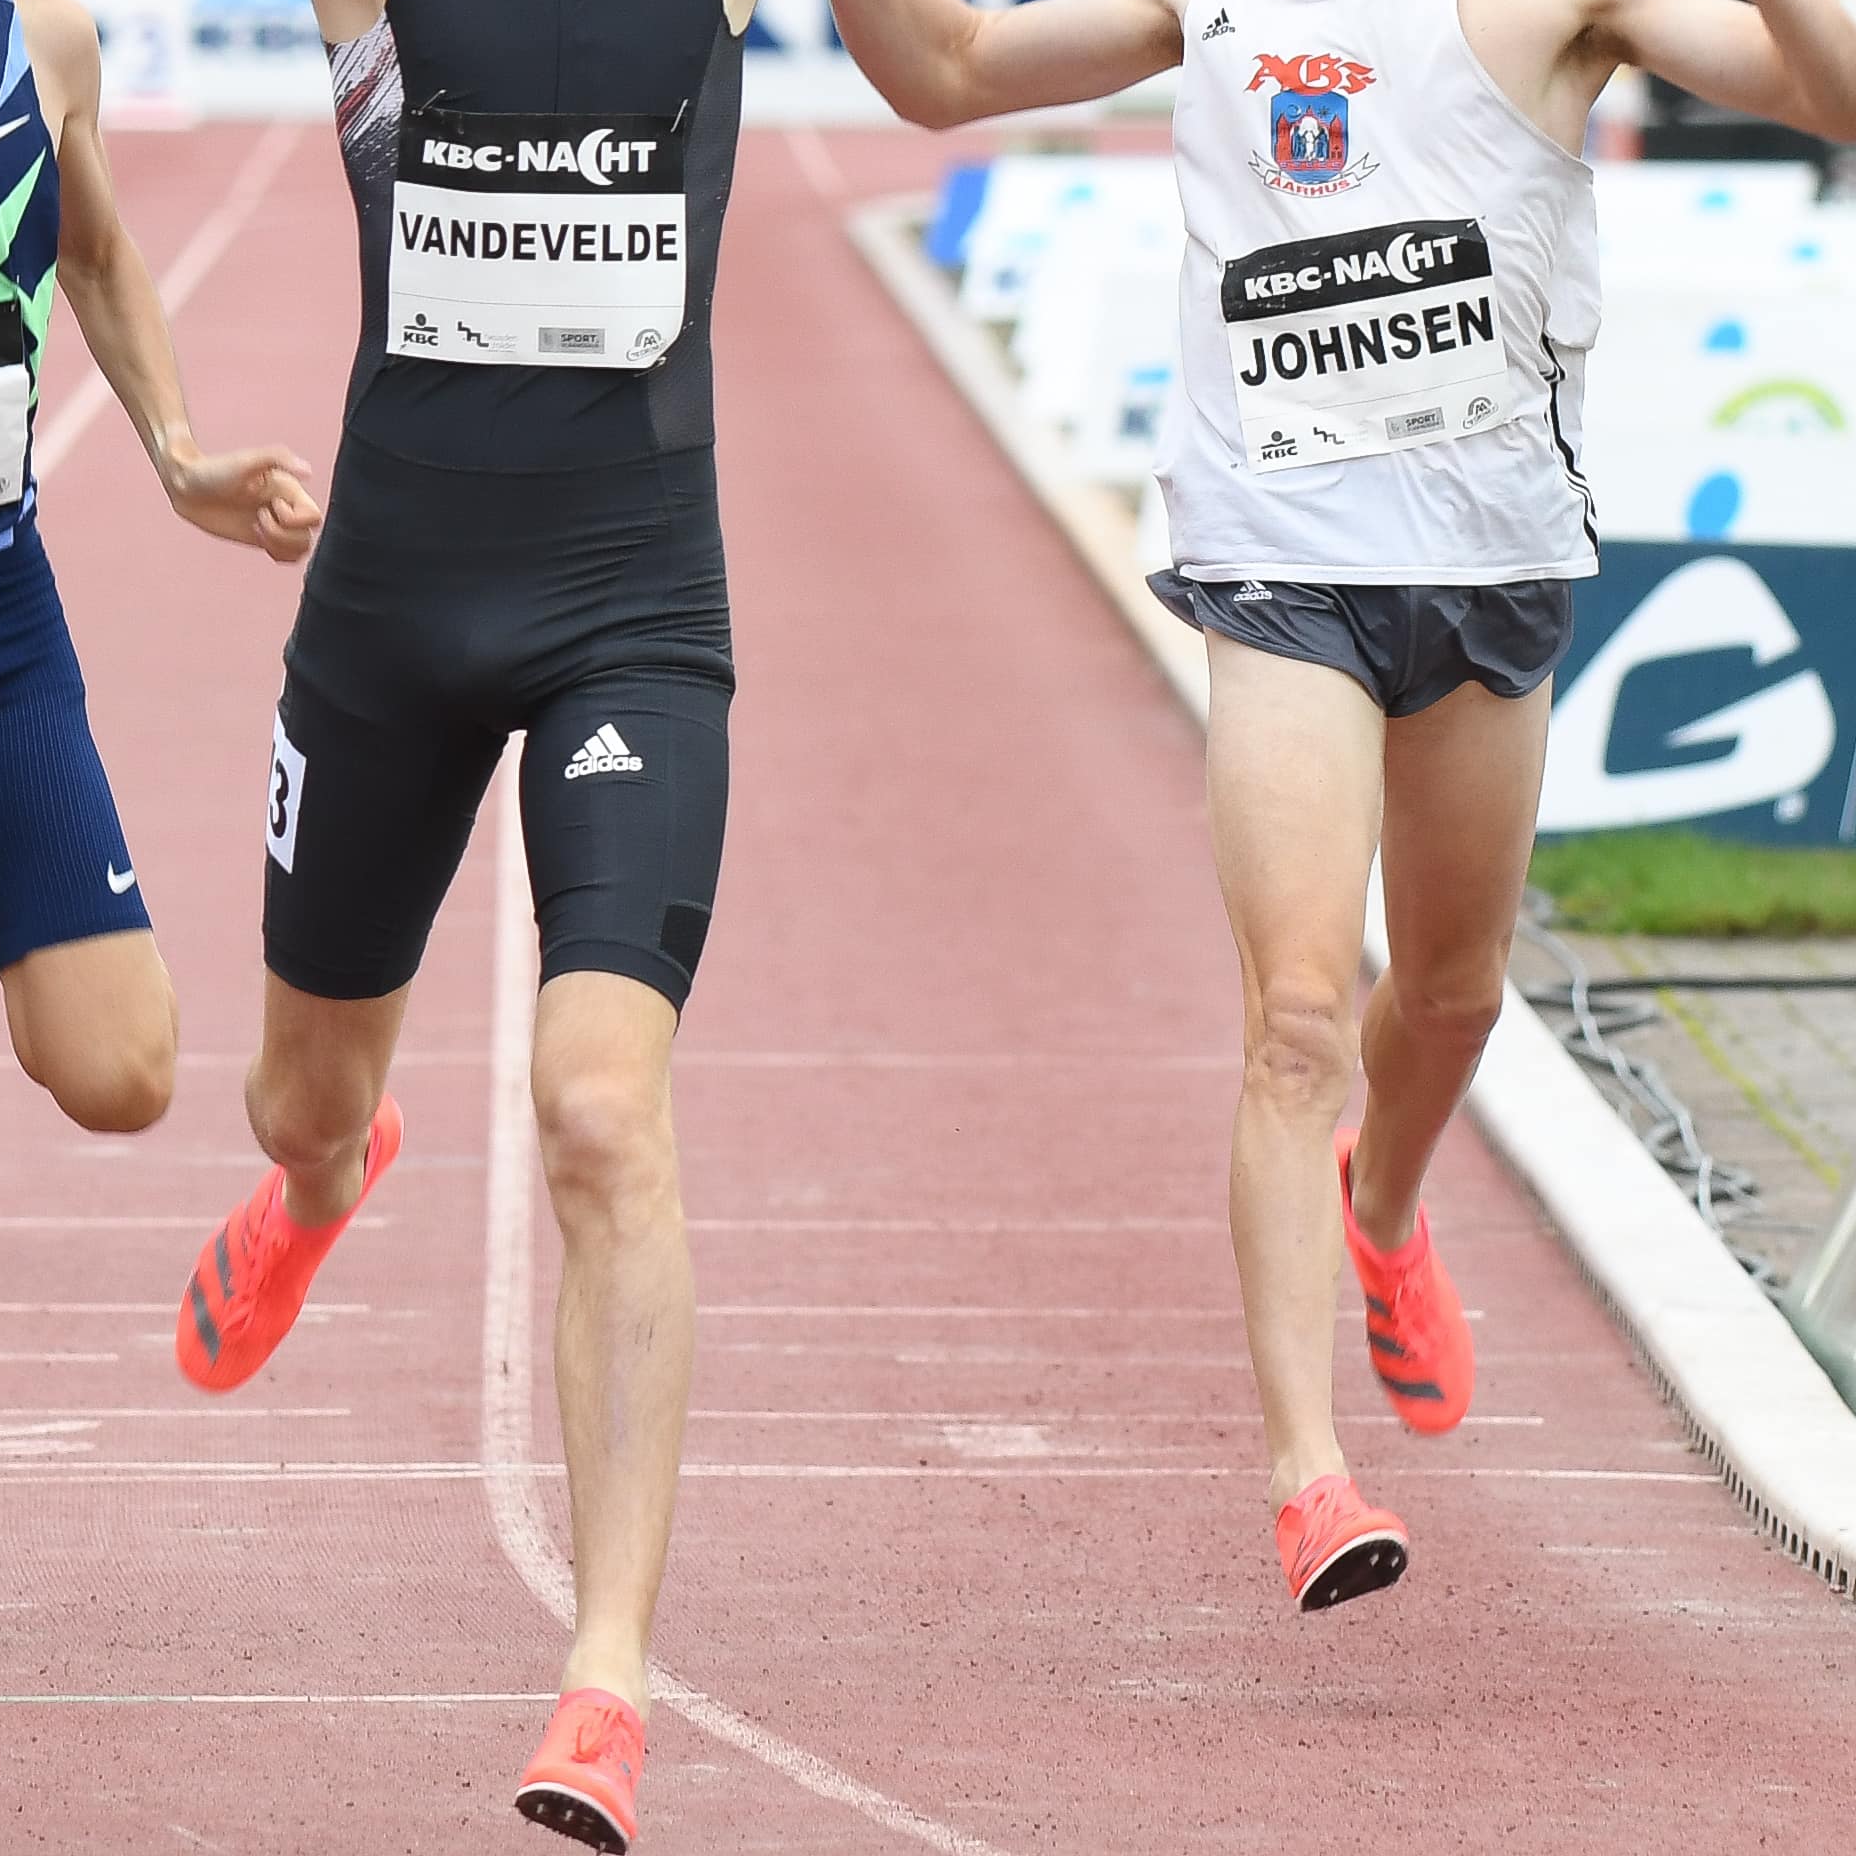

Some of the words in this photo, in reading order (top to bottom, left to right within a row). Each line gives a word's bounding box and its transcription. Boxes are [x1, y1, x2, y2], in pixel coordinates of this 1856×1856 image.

[422, 128, 657, 186] KBC-NACHT
[1268, 174, 1351, 197] AARHUS
[398, 211, 679, 262] VANDEVELDE
[1244, 232, 1459, 301] KBC-NACHT
[403, 331, 439, 347] KBC
[1240, 296, 1495, 386] JOHNSEN
[1261, 445, 1298, 461] KBC
[564, 755, 644, 779] adidas
